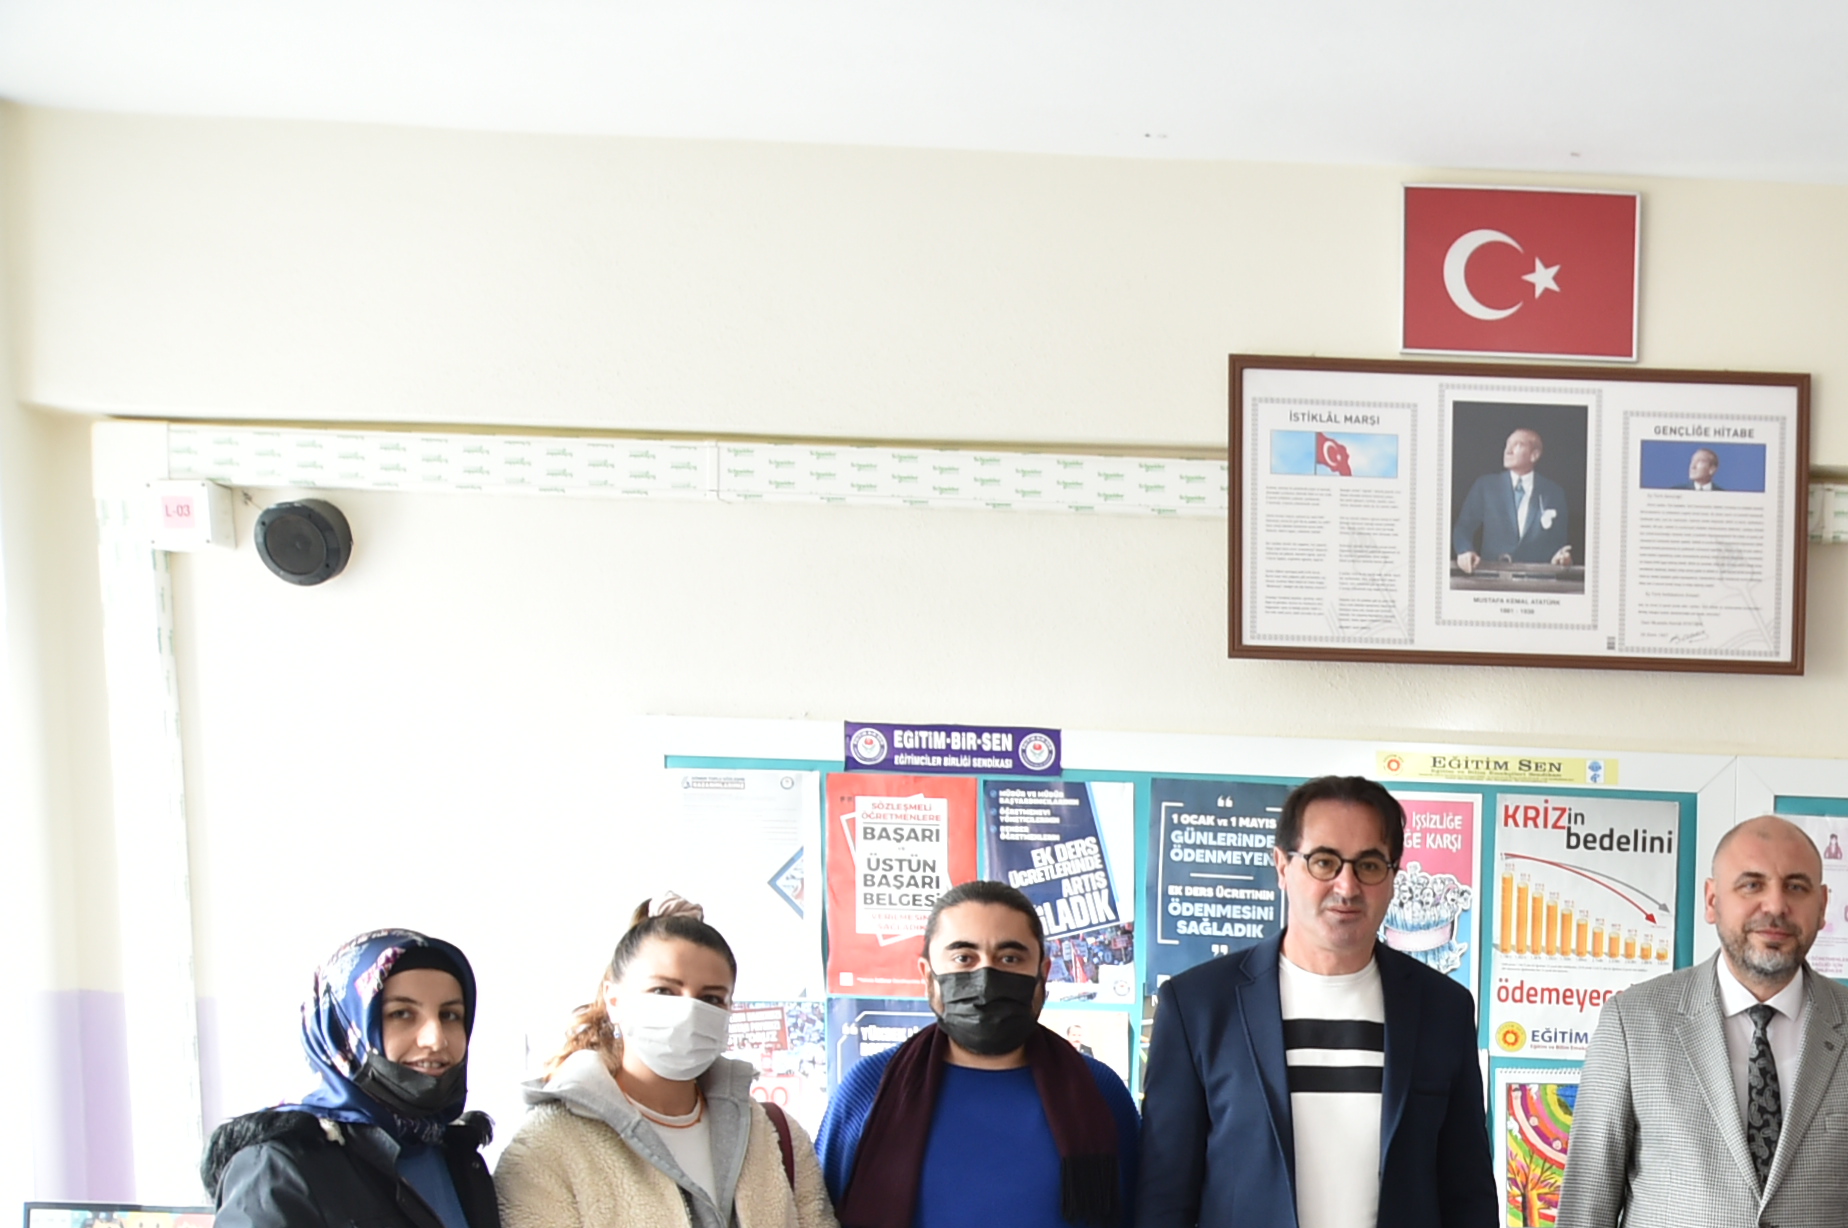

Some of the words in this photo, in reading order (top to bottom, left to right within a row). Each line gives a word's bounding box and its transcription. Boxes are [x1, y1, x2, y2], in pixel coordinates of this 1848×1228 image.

[1289, 410, 1341, 424] İSTİKLÂL
[1343, 414, 1380, 426] MARŞI
[1654, 424, 1711, 438] GENÇLİĞE
[1713, 426, 1755, 439] HİTABE
[1172, 813, 1179, 824] 1
[1179, 814, 1216, 826] OCAK
[1230, 817, 1238, 827] 1
[1238, 817, 1277, 830] MAYIS
[863, 826, 940, 843] BAŞARI
[1170, 827, 1275, 849] GÜNLERİNDE
[1425, 832, 1462, 853] KARŞI
[1566, 825, 1673, 854] bedelini
[1031, 845, 1053, 869] EK
[1055, 836, 1099, 862] DERS
[1169, 844, 1275, 867] ÖDENMEYEN
[867, 852, 937, 874] ÜSTÜN
[863, 873, 940, 890] BAŞARI
[1168, 898, 1275, 921] ÖDENMESİNİ
[1176, 919, 1264, 938] SAĞLADIK
[1531, 1028, 1589, 1044] EĞİTİM
